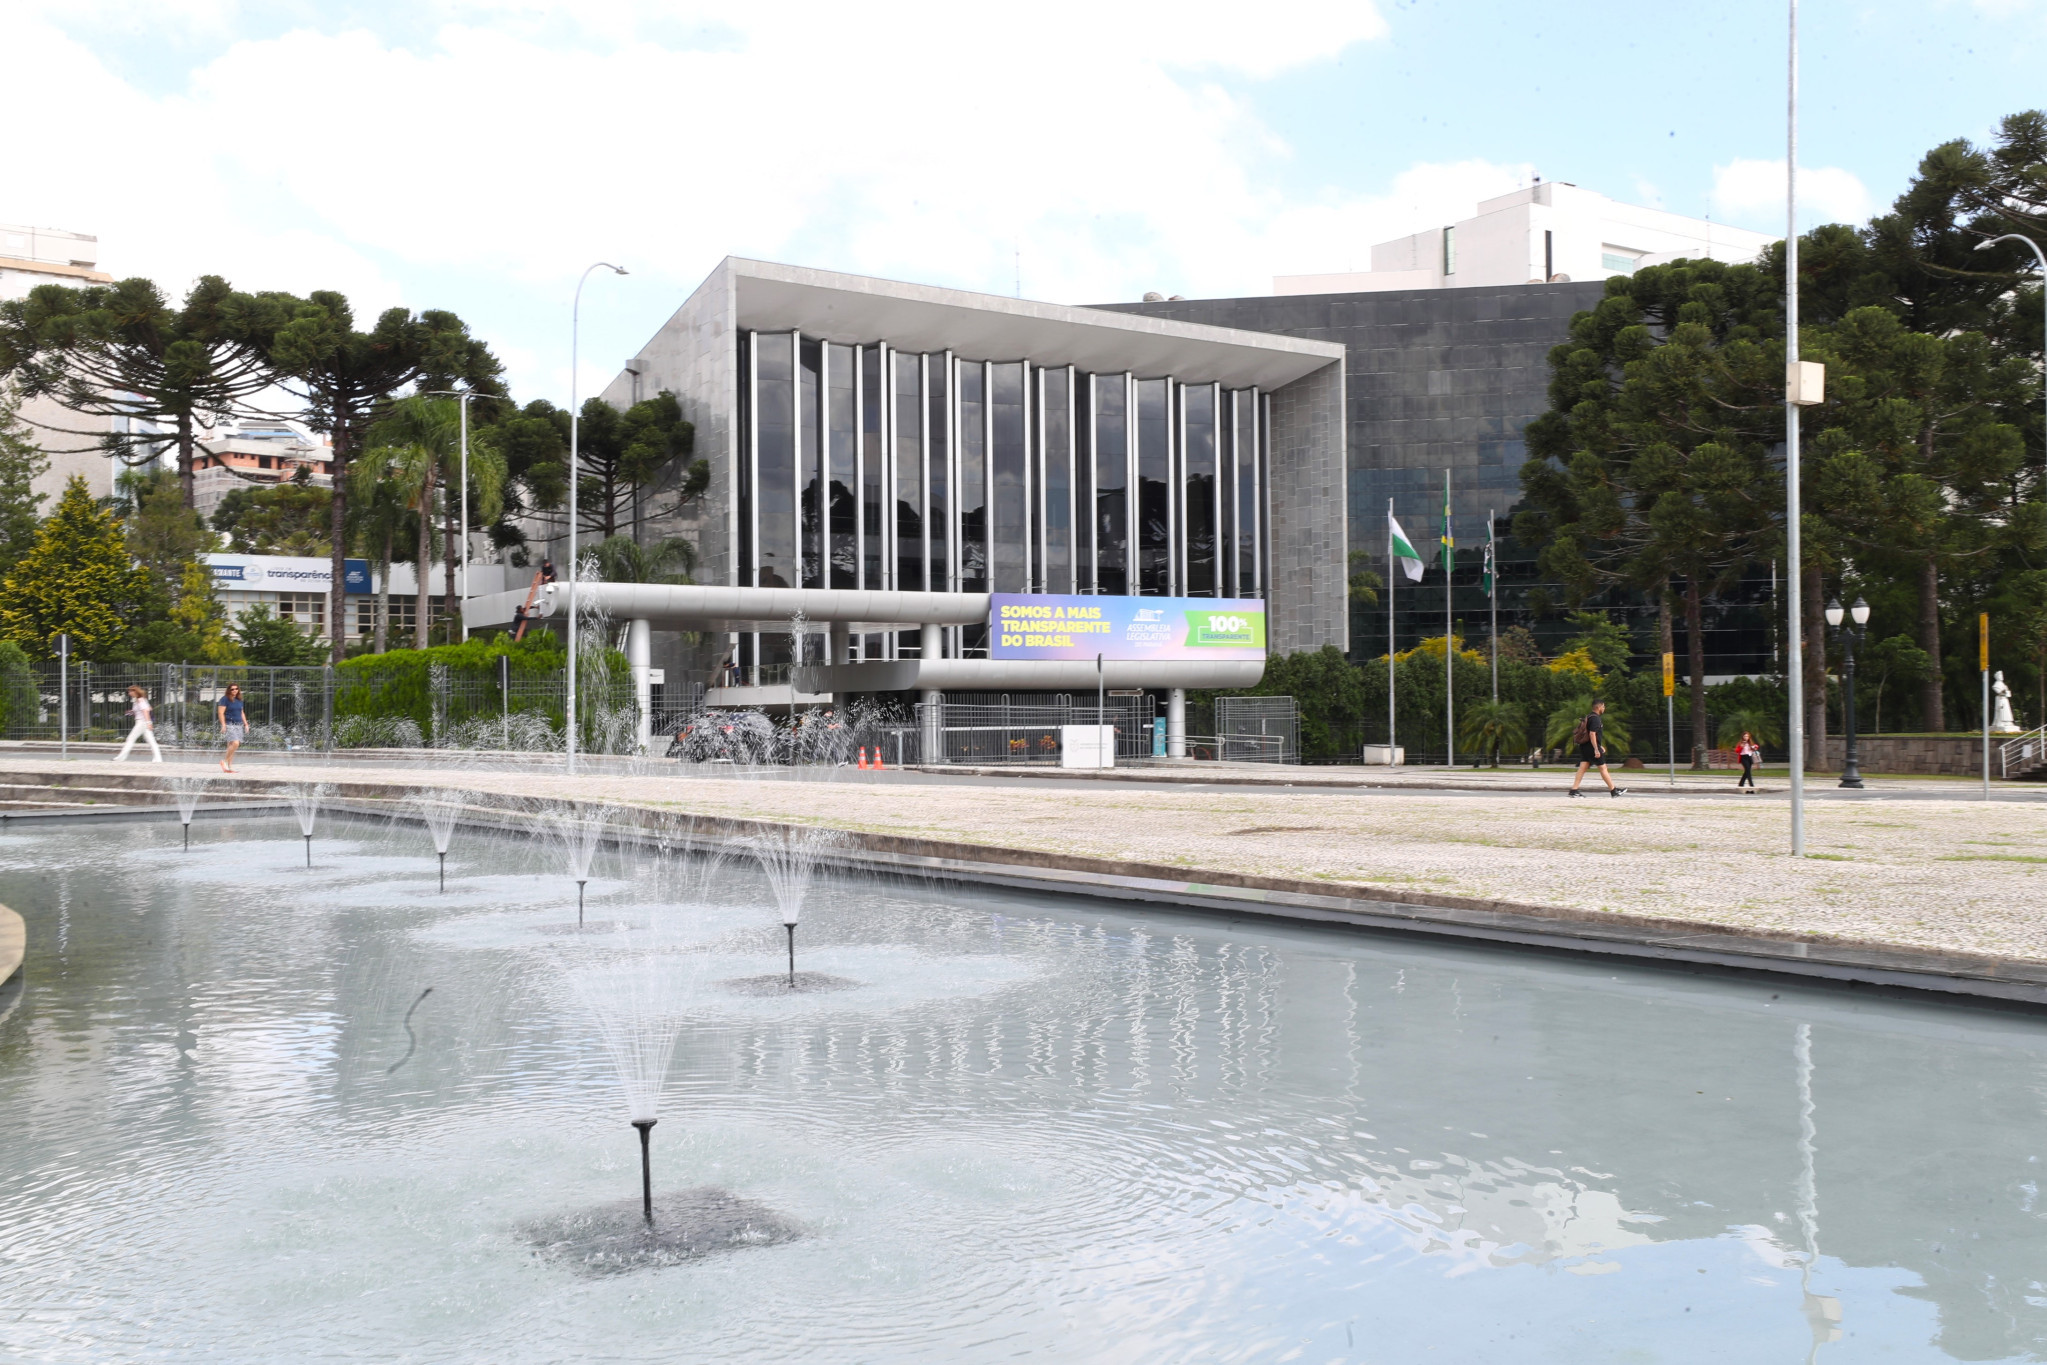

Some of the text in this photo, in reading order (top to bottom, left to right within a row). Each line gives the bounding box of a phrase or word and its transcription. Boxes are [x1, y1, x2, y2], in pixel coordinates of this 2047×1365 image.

[267, 570, 332, 580] transparênc
[1000, 605, 1102, 619] SOMOS A MAIS
[1000, 620, 1111, 633] TRANSPARENTE
[1126, 624, 1171, 632] ASSEMBLEIA
[1208, 615, 1247, 632] 100%
[1001, 634, 1075, 647] DO BRASIL
[1126, 632, 1171, 641] LEGISLATIVA
[1202, 633, 1250, 641] TRANSPARENTE
